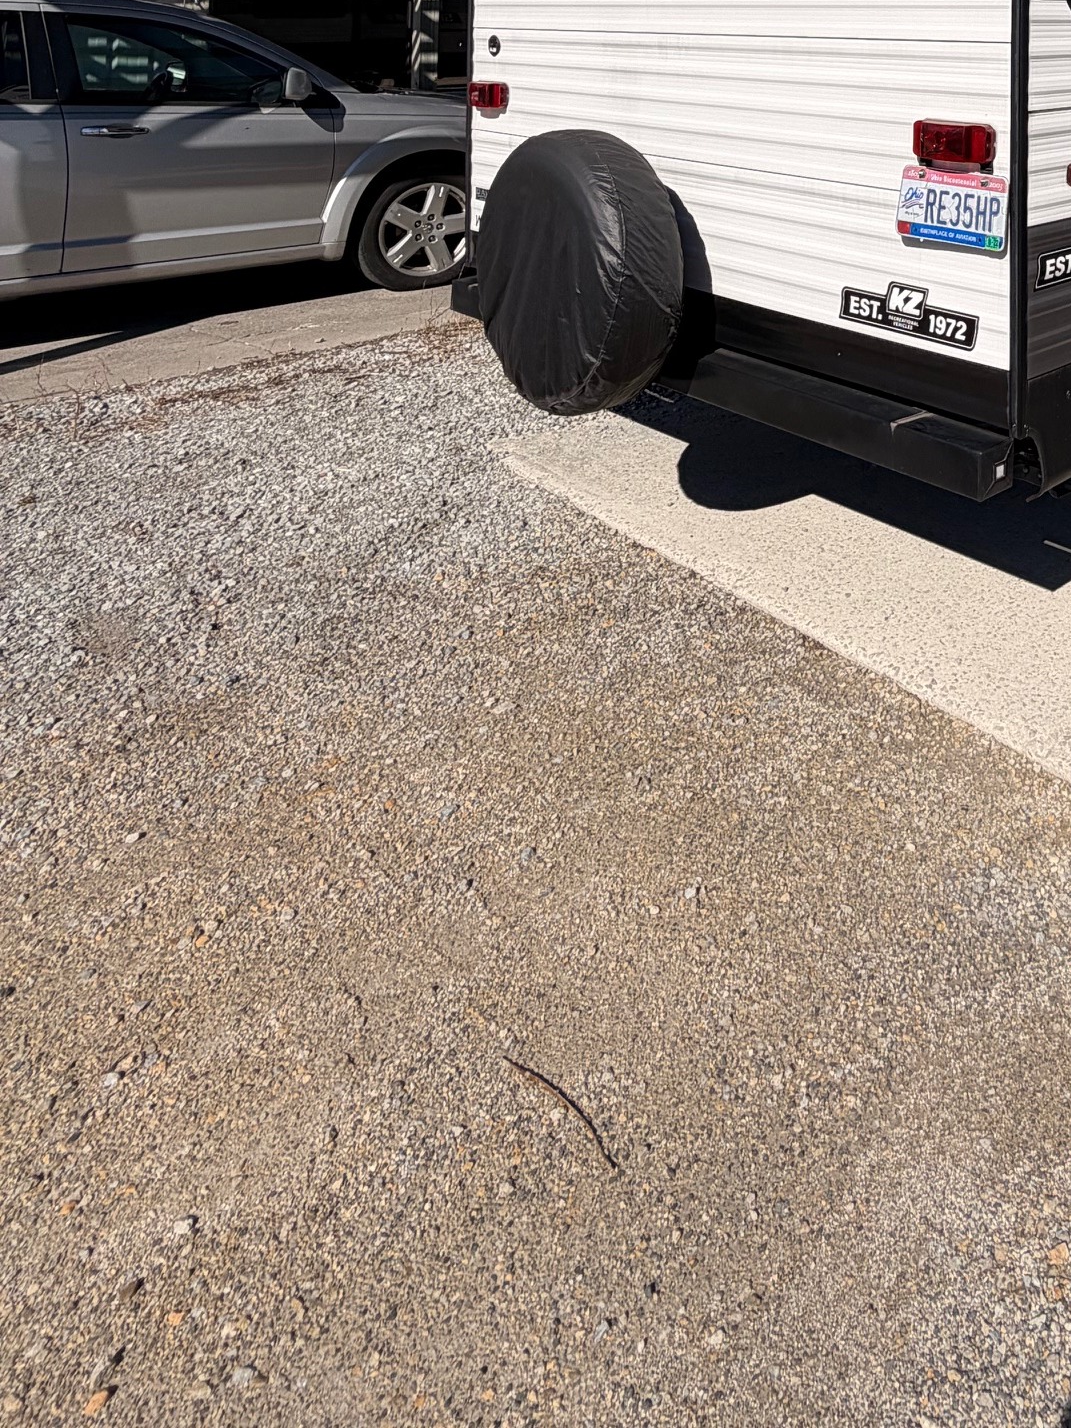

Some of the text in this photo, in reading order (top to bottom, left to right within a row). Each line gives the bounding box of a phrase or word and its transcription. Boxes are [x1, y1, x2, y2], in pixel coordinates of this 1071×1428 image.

[924, 188, 1001, 234] RE35HP
[849, 287, 967, 341] EST. KZ 1972
